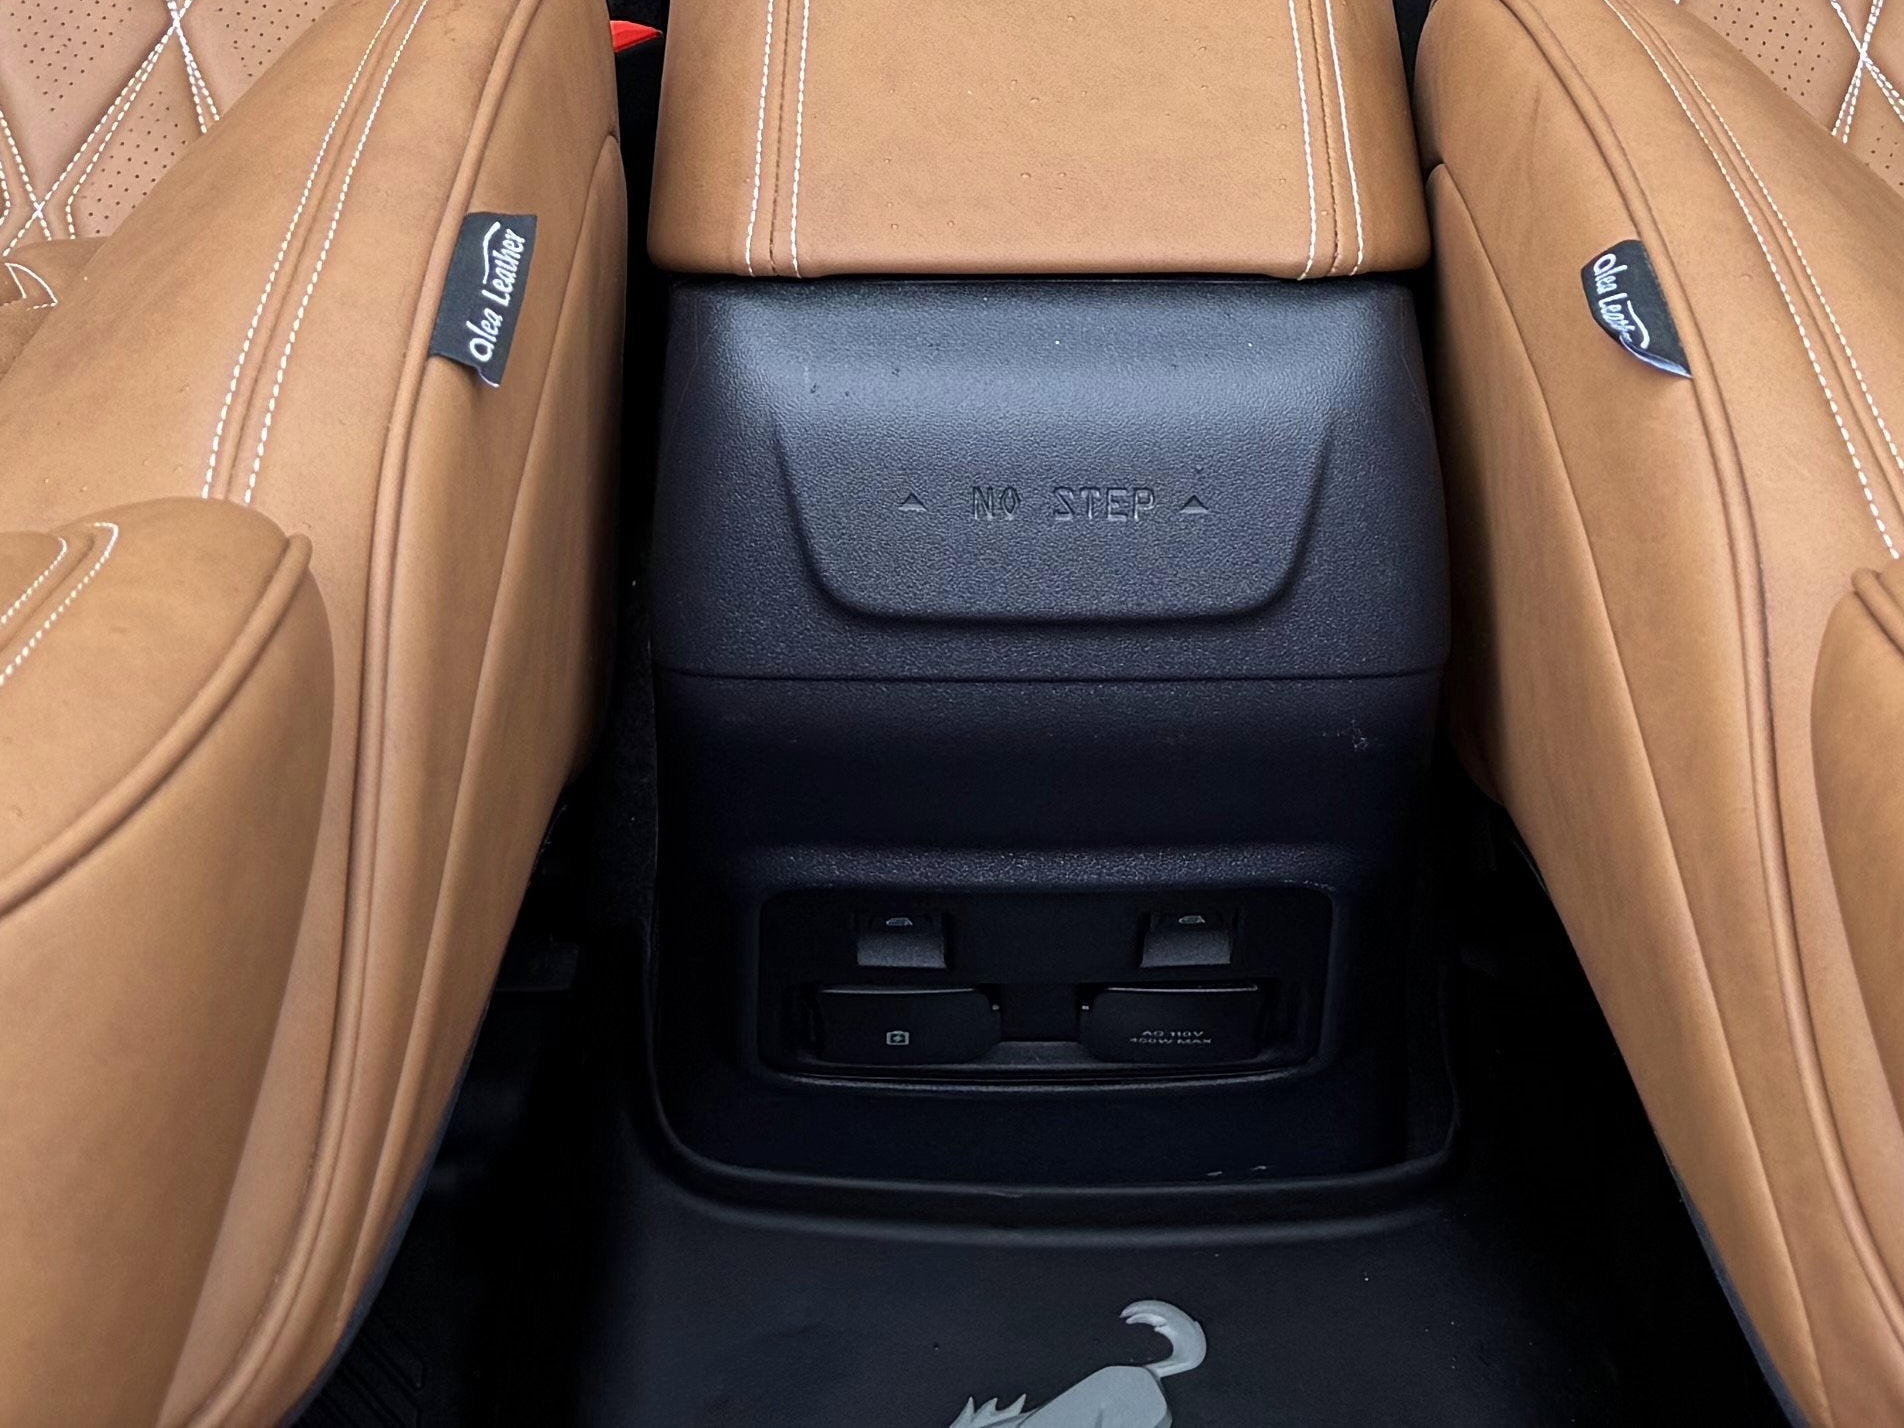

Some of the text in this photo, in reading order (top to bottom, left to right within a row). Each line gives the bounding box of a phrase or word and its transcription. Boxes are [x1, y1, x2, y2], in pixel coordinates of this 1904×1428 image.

[482, 228, 526, 307] Leather
[972, 485, 1155, 522] NO STEP
